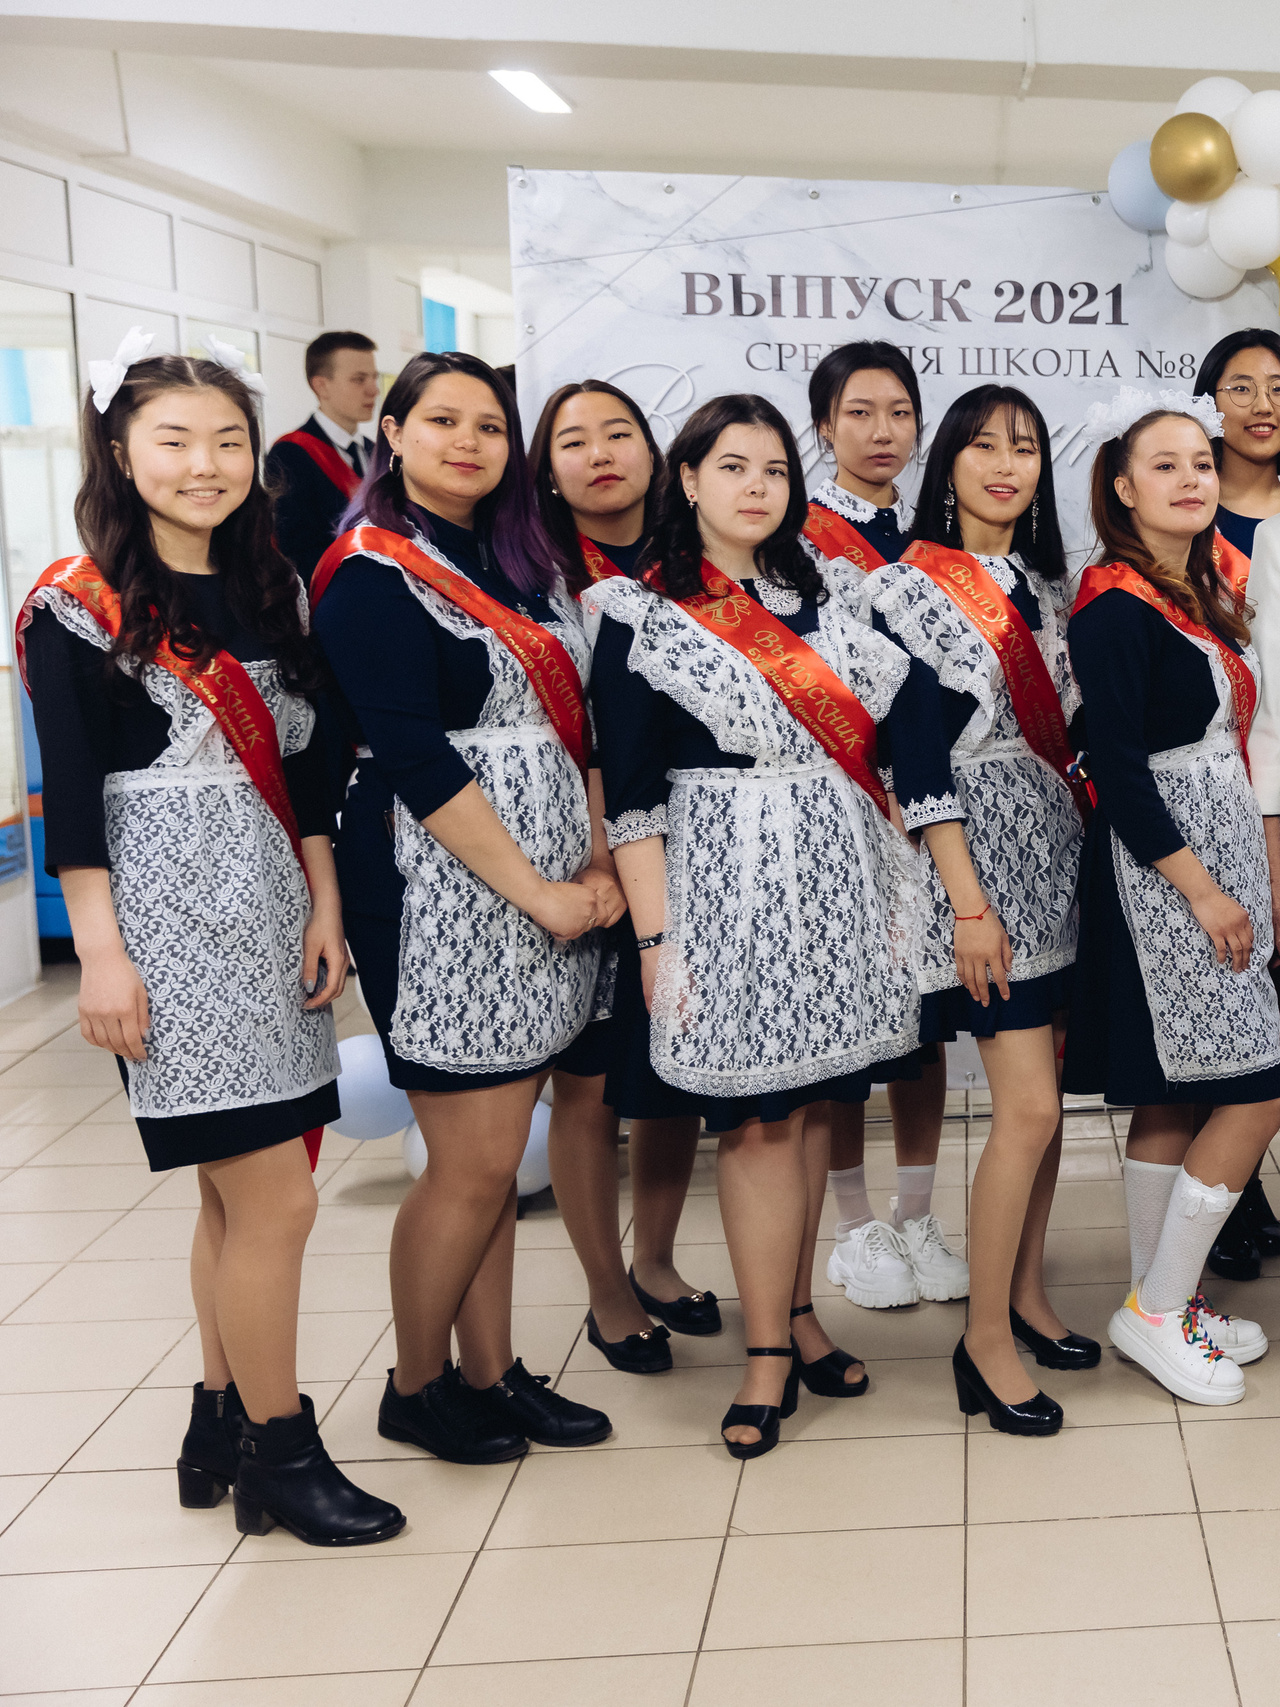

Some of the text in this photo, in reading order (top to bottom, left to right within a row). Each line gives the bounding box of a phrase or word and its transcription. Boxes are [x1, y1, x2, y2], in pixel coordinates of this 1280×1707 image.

[680, 271, 1129, 326] ВЫПУСК 2021
[745, 342, 1197, 380] СРЕЯ ШКОЛА №8
[948, 563, 1037, 700] Выпускник
[747, 647, 840, 752] Будрина Кристина
[753, 630, 865, 757] Выпускник
